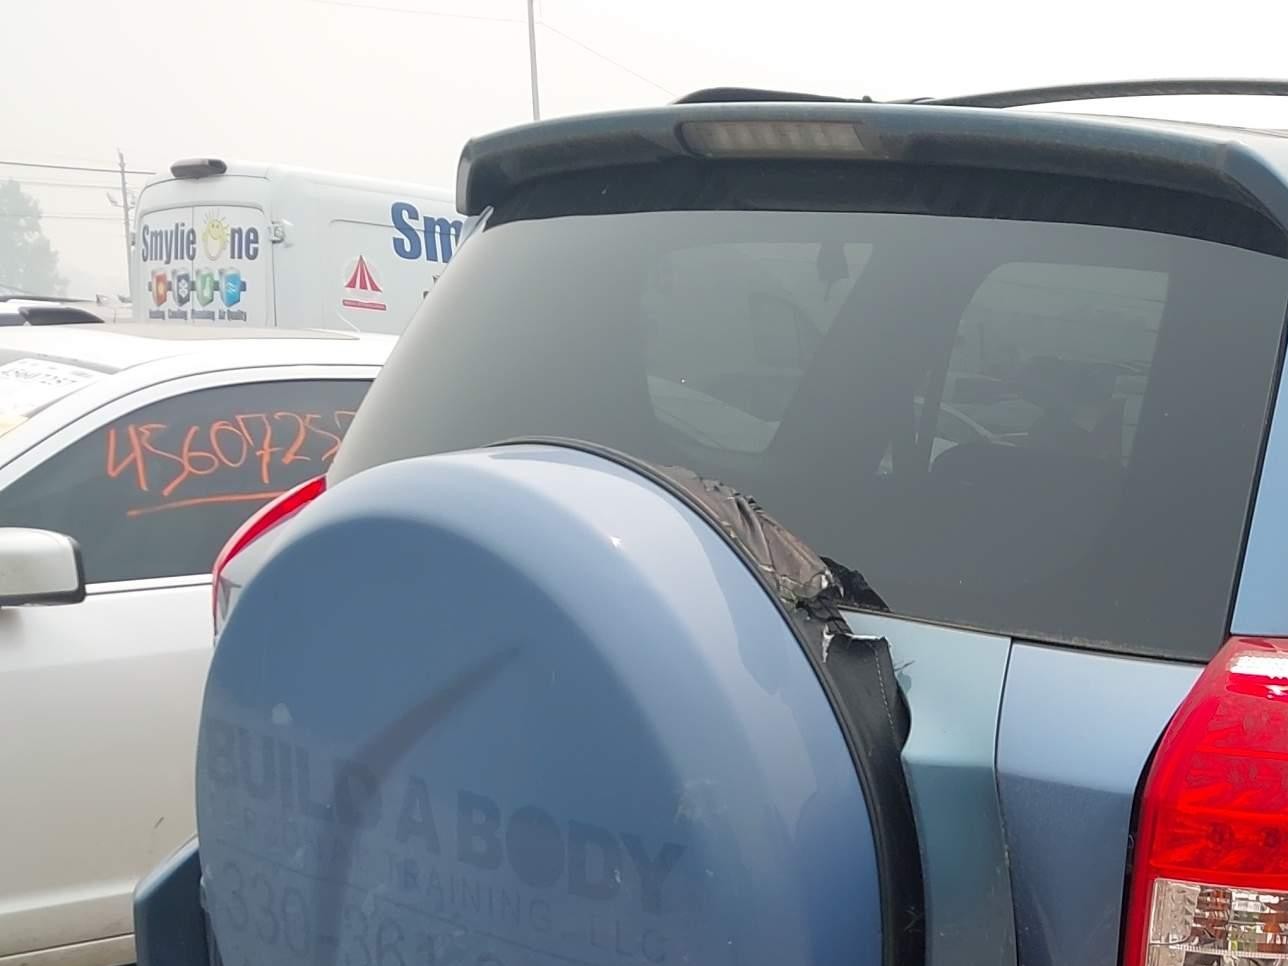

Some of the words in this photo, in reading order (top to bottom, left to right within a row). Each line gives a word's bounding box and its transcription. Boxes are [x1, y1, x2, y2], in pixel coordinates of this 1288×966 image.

[141, 222, 197, 264] Smylie
[396, 774, 441, 855] A
[456, 789, 688, 914] BODY
[589, 914, 668, 964] LLC
